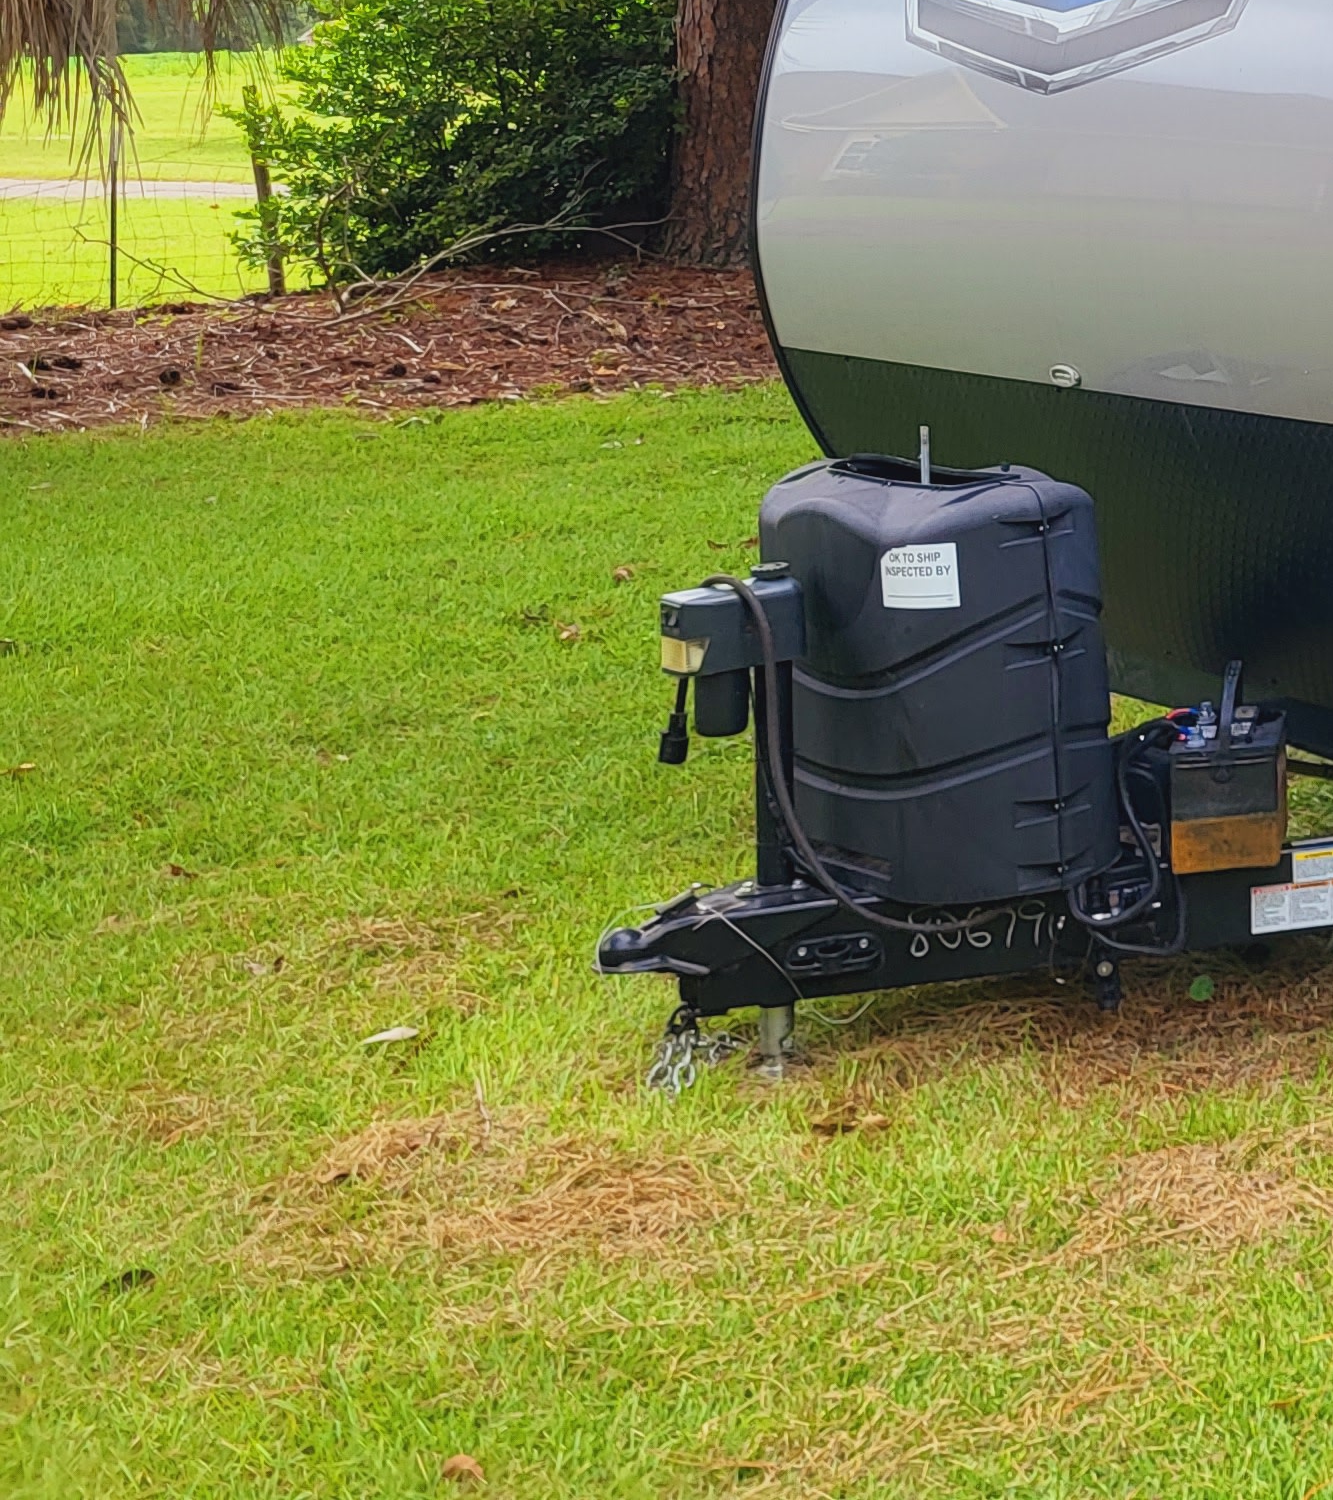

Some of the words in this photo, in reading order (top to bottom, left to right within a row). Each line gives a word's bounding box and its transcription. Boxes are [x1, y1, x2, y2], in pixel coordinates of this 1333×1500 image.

[889, 553, 900, 563] OK
[902, 553, 914, 563] TO
[917, 552, 941, 563] SHIP
[936, 565, 950, 576] BY
